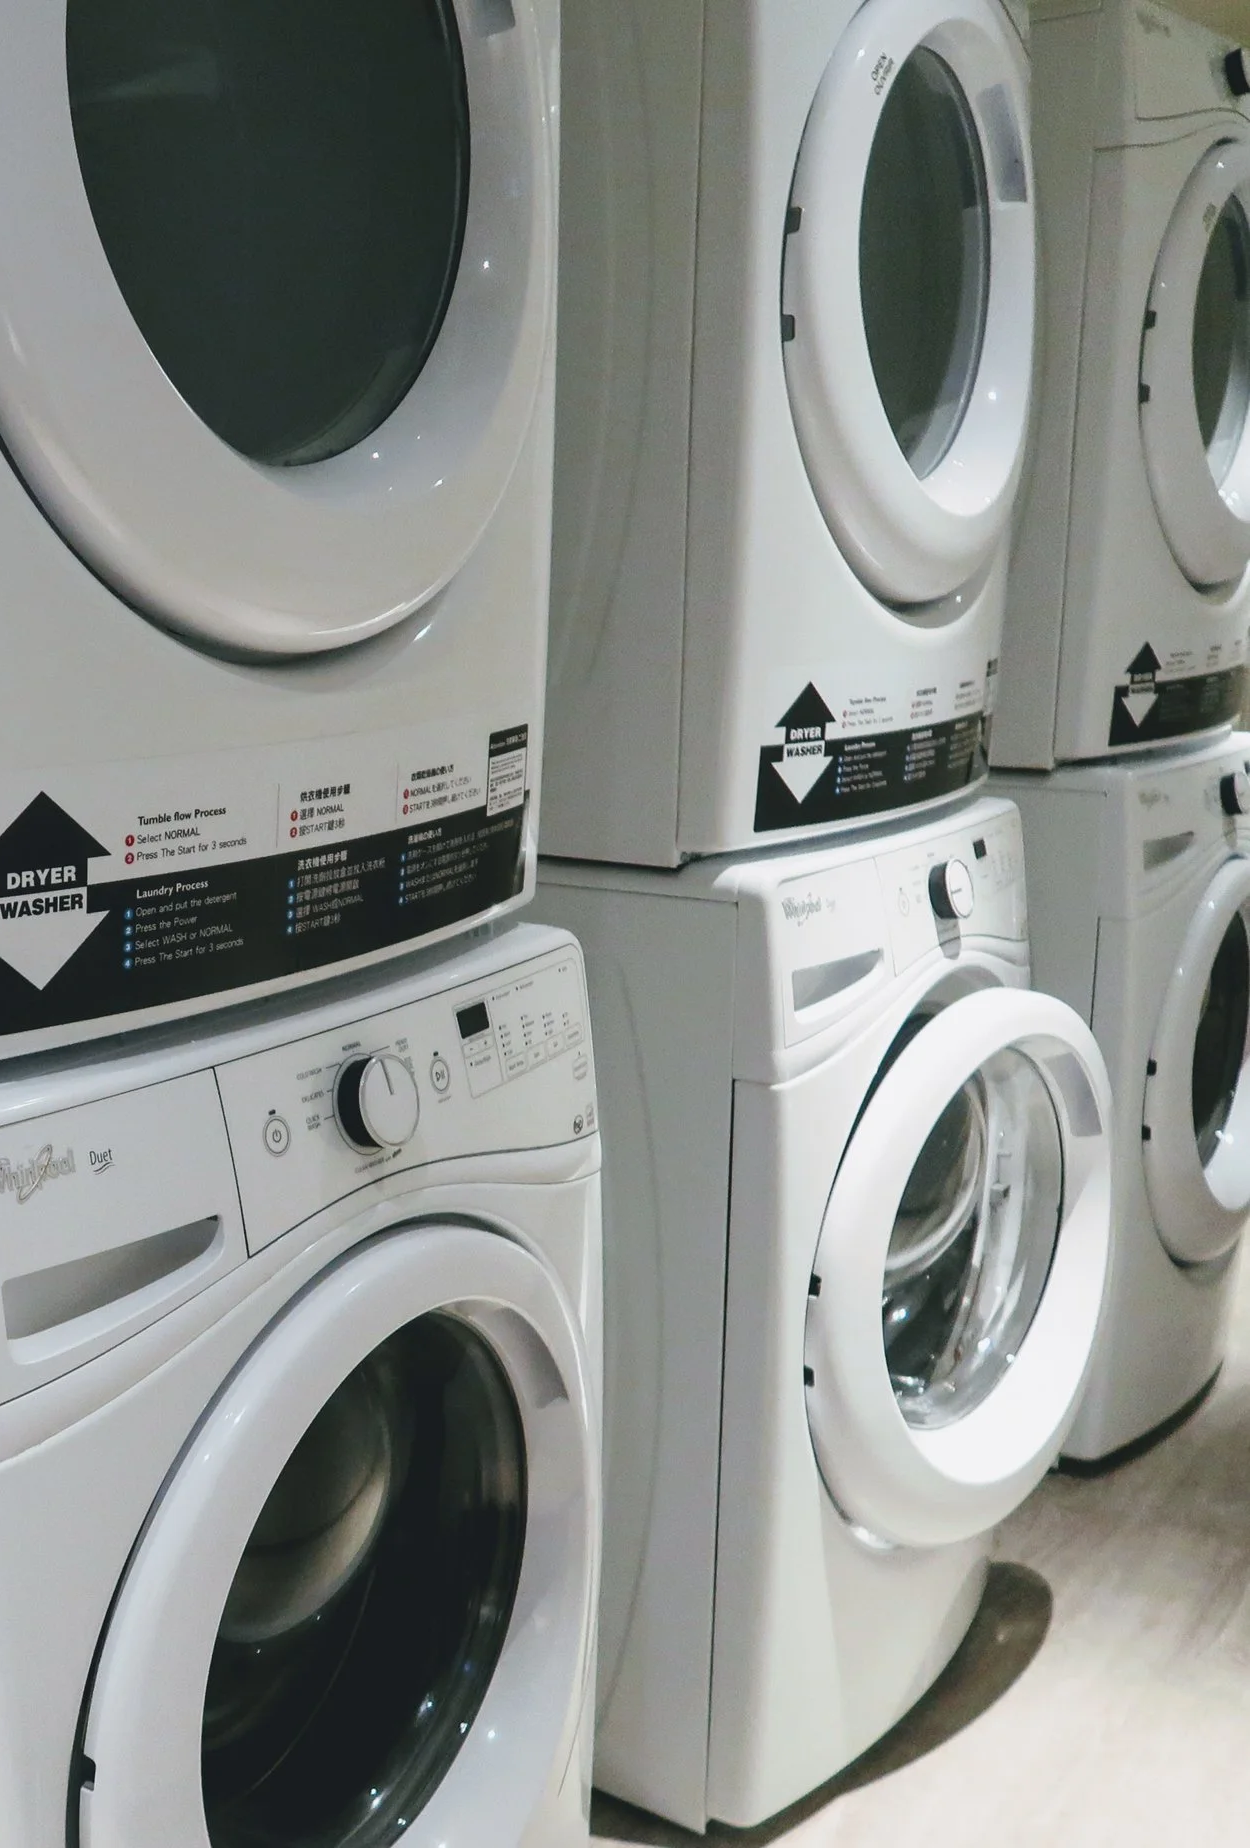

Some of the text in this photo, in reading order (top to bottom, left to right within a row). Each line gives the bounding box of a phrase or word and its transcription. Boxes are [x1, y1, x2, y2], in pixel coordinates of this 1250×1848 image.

[790, 726, 822, 740] DRYER
[786, 744, 823, 758] WASHER
[137, 807, 227, 826] Tumble flow Process
[316, 803, 345, 816] NORMAL
[137, 834, 162, 845] Select
[164, 827, 200, 840] NORMAL
[136, 851, 158, 861] Press
[161, 847, 175, 858] The
[177, 845, 196, 856] Start
[198, 842, 209, 852] for
[211, 841, 217, 850] 3
[219, 837, 247, 849] seconds
[7, 865, 76, 890] DRYER
[136, 880, 209, 899] Laundry Process
[0, 894, 84, 919] WASHER
[135, 907, 156, 918] Open
[159, 903, 173, 913] and
[175, 900, 188, 911] put
[190, 898, 202, 907] the
[204, 892, 237, 906] detergent
[135, 923, 157, 933] Press
[159, 920, 171, 929] the
[173, 916, 198, 927] Power
[135, 939, 159, 950] Select
[162, 932, 187, 945] WASH
[189, 931, 197, 939] or
[199, 923, 233, 938] NORMAL
[135, 957, 156, 966] Press
[159, 952, 172, 961] The
[175, 949, 193, 959] Start
[195, 945, 206, 955] for
[208, 942, 214, 952] 3
[216, 938, 244, 951] seconds
[89, 1148, 114, 1166] Duet
